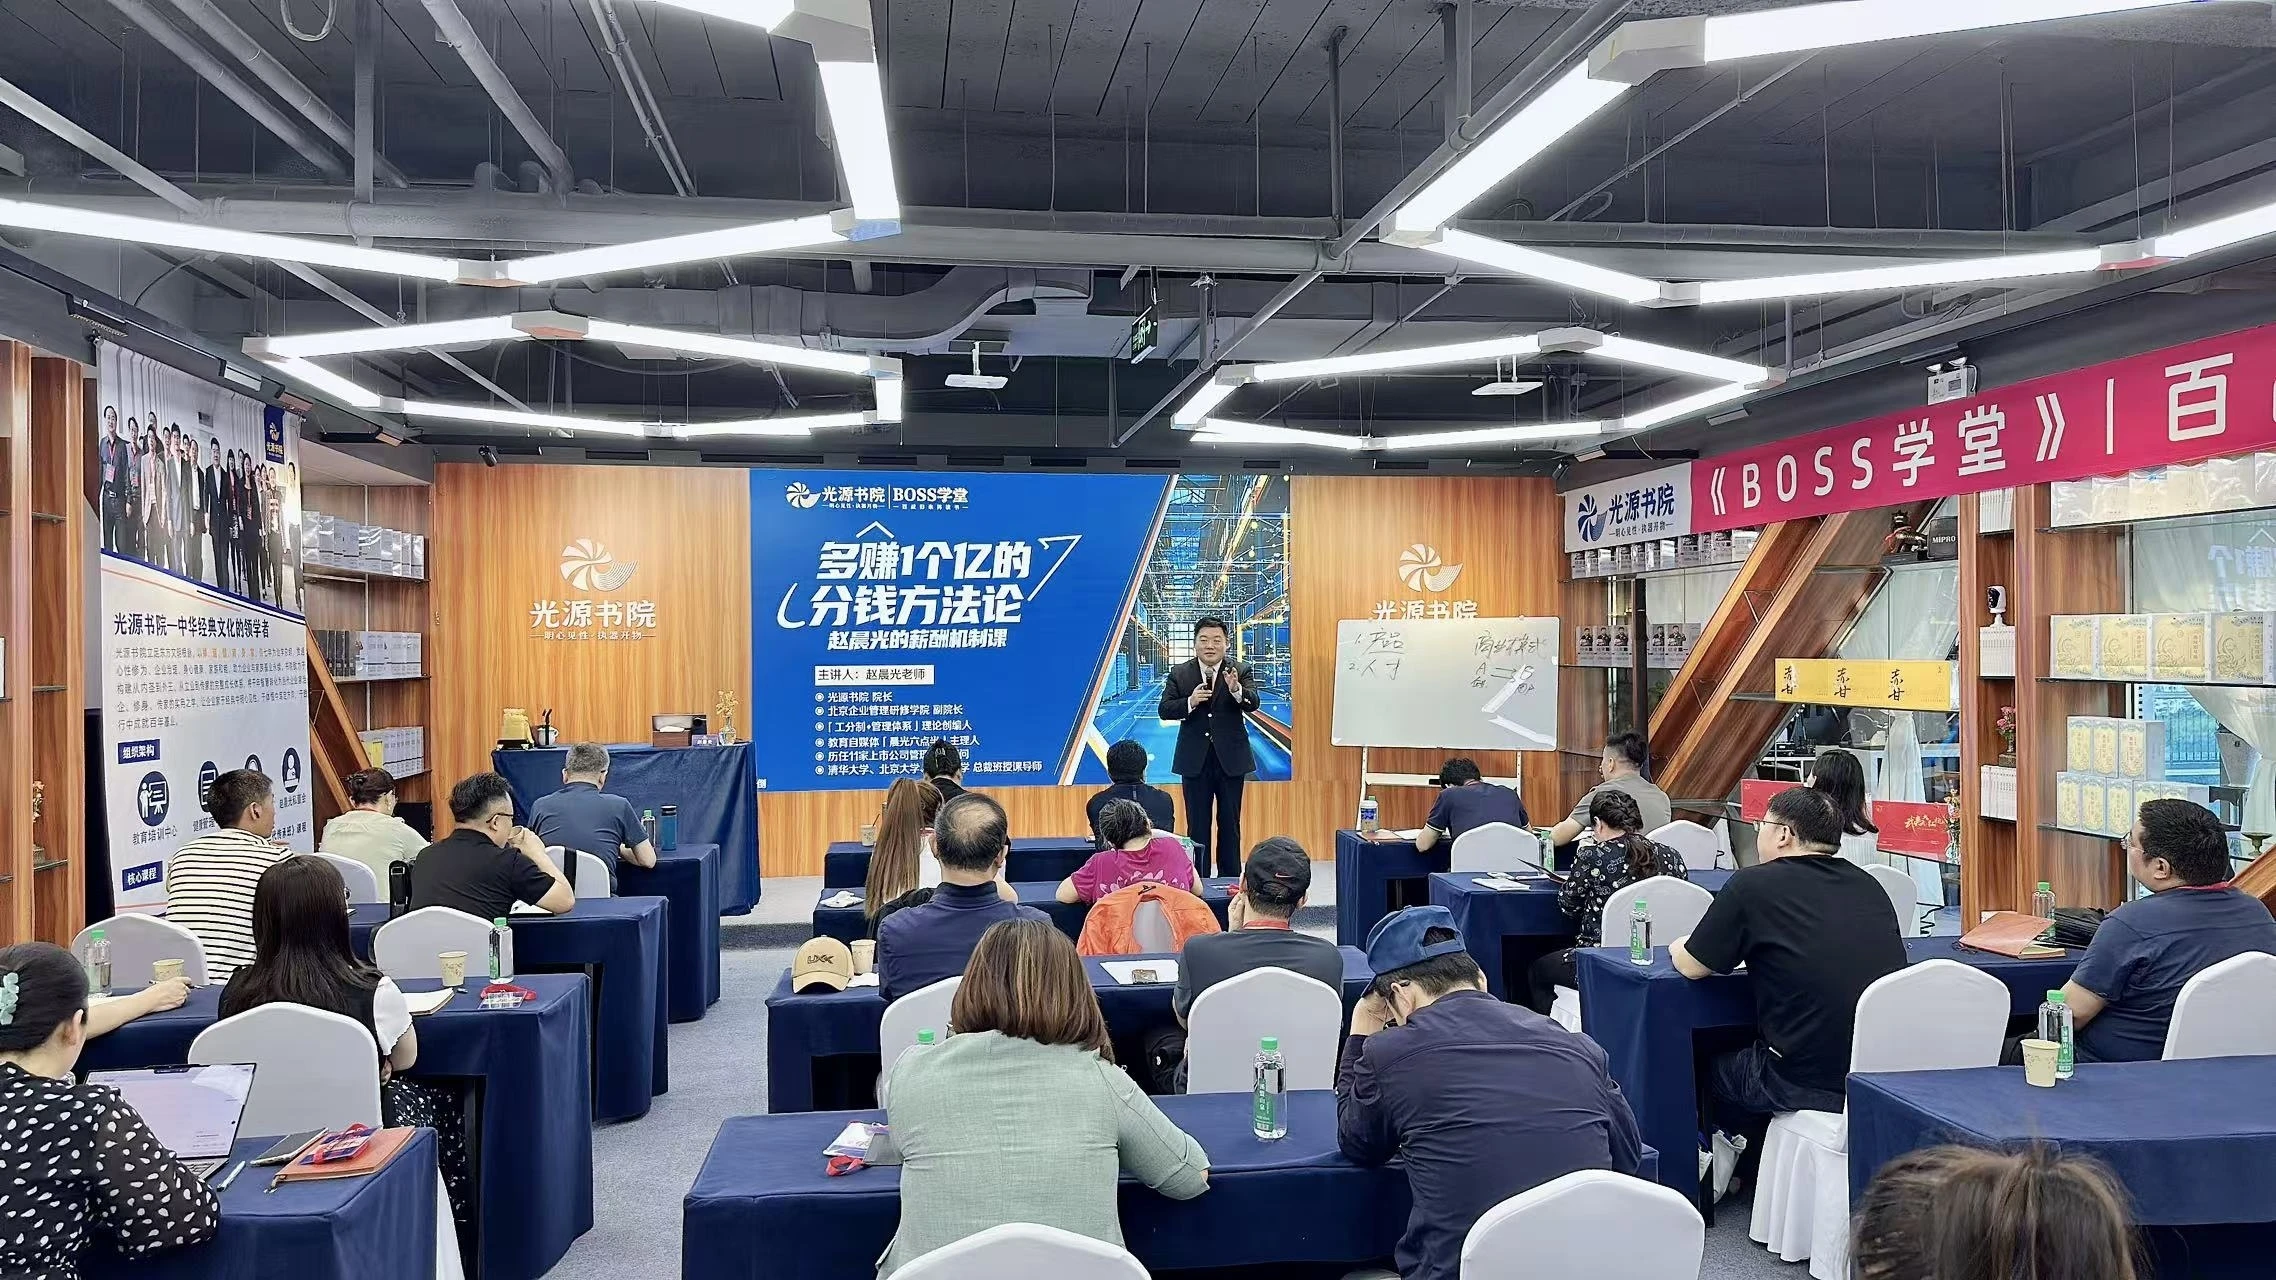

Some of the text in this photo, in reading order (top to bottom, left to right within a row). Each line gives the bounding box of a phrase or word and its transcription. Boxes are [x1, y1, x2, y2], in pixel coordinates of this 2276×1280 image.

[822, 486, 969, 503] 光源书院 BOSS学堂
[1609, 483, 1674, 525] 光源书院
[1932, 535, 1956, 544] MIPRO
[816, 541, 1032, 581] 多赚1个亿的
[529, 600, 657, 629] 光源书院
[809, 584, 1025, 626] 分钱方法论
[1372, 600, 1479, 620] 光源书院
[828, 628, 1009, 650] 赵晨光的薪酬机制课
[872, 691, 893, 702] 院长
[828, 704, 963, 717] 北京企业管理研修学院 副院长
[123, 744, 155, 759] 组织架构
[132, 826, 178, 845] 教育培训中心
[127, 867, 157, 885] 核心课程
